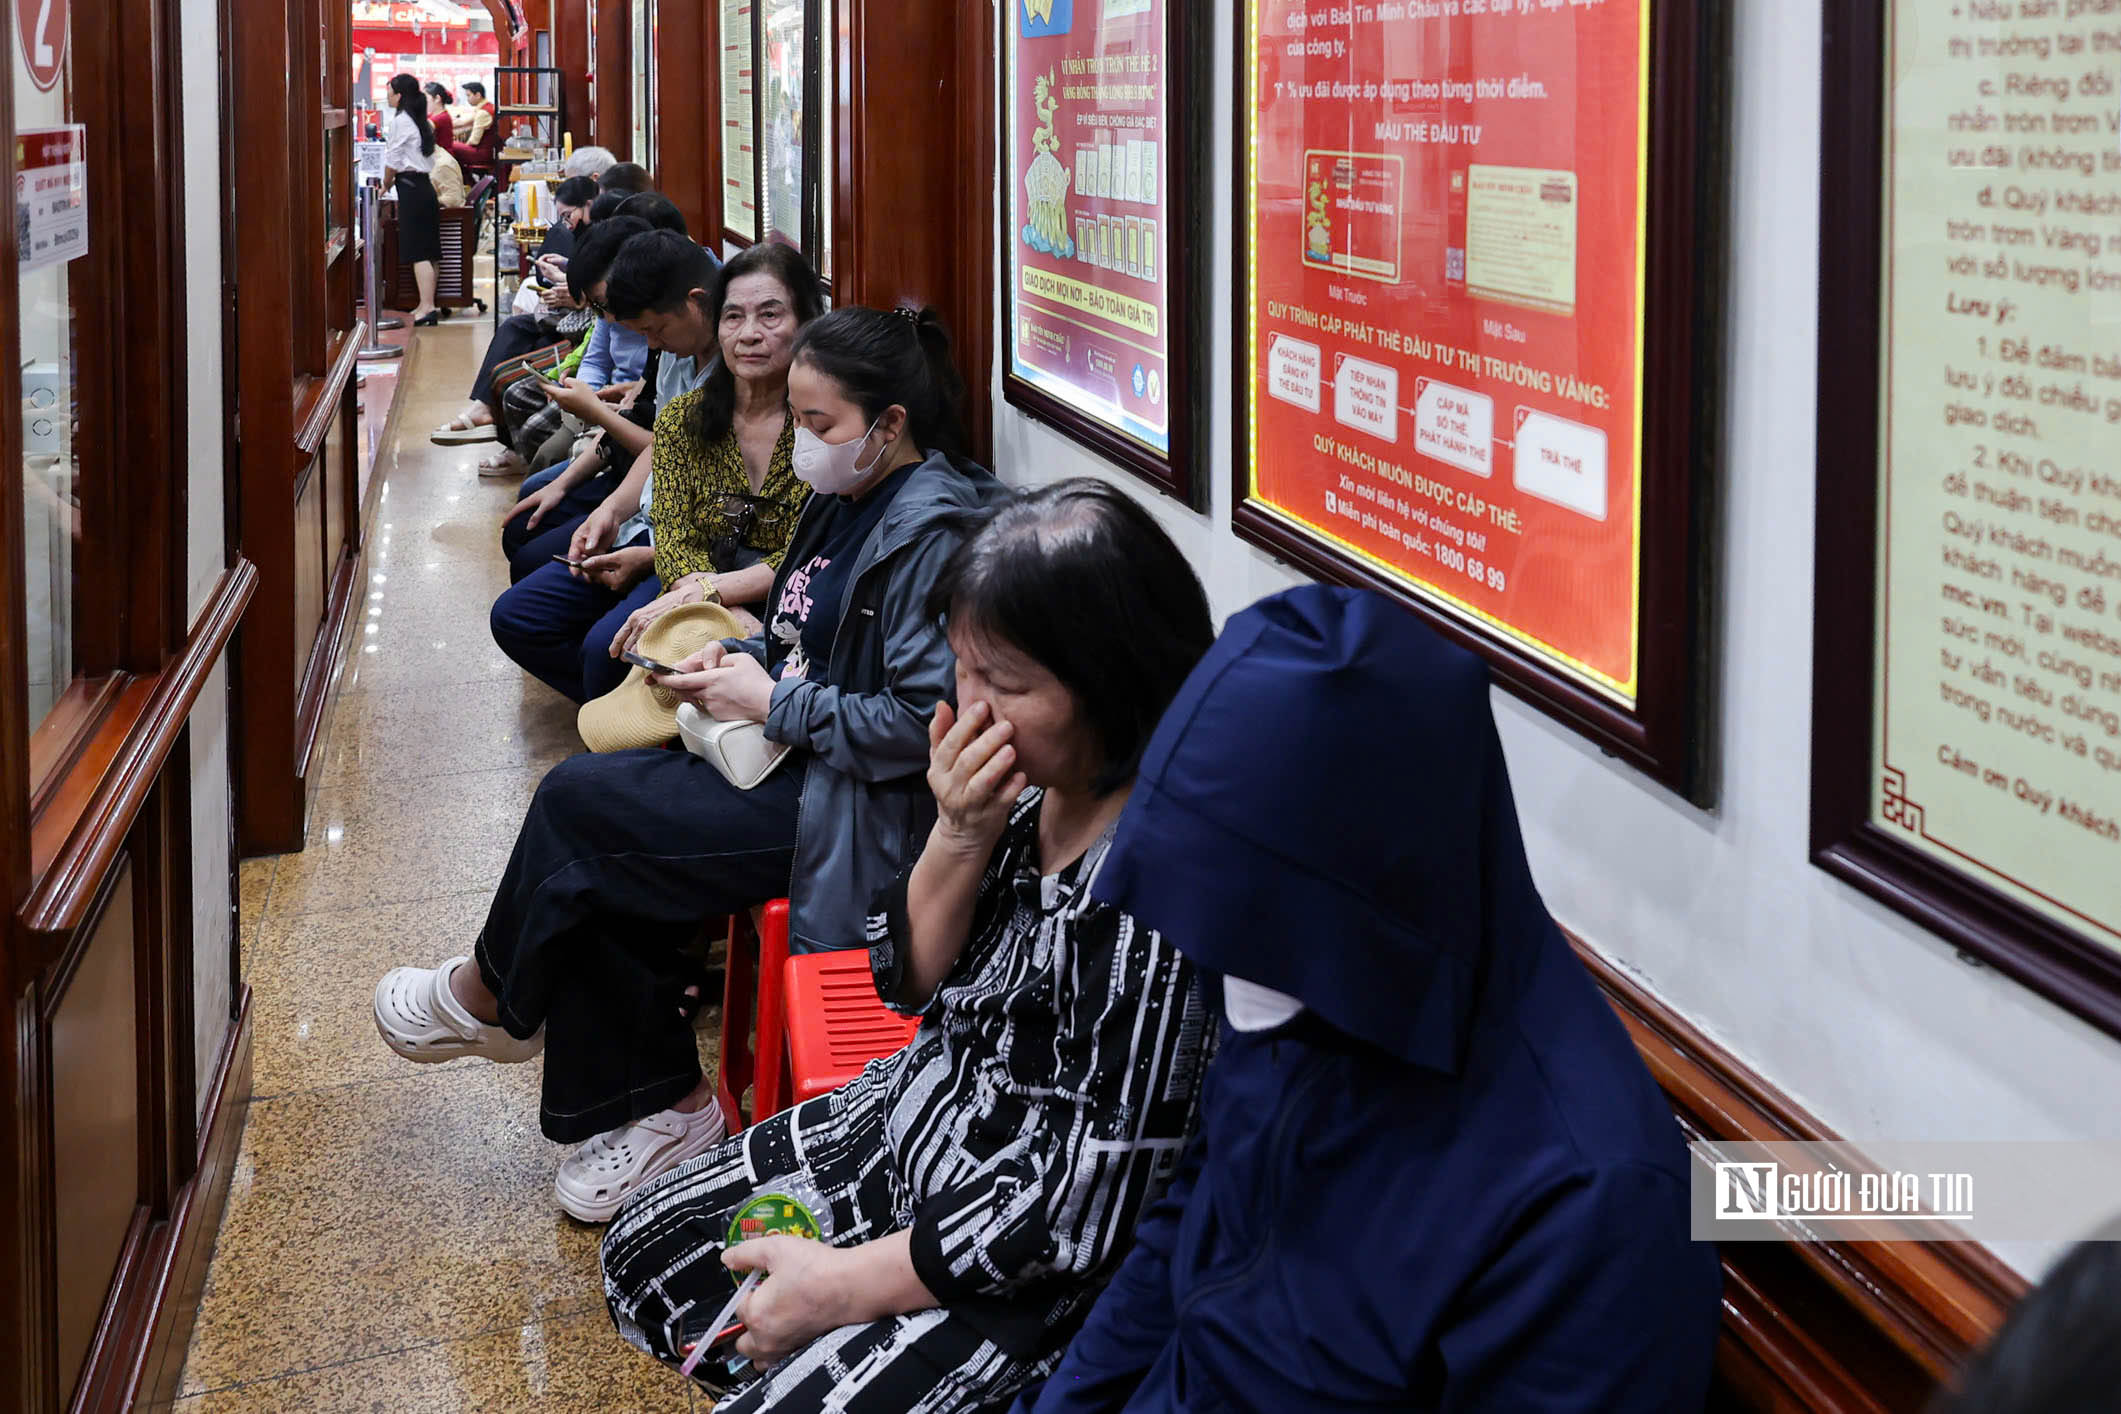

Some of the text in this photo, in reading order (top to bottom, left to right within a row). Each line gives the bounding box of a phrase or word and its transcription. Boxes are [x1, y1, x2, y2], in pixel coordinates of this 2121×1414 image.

[1287, 0, 1488, 32] dịch với Bảo Tín Minh Châu và các
[1287, 37, 1347, 59] của công ty.
[1299, 84, 1313, 99] ưu
[1315, 80, 1330, 98] đãi
[1332, 80, 1361, 102] được
[1363, 80, 1378, 101] áp
[1380, 80, 1410, 103] dụng
[1412, 80, 1440, 99] theo
[1442, 79, 1474, 104] từng
[1476, 78, 1505, 100] thời
[1507, 72, 1549, 100] điểm.
[2005, 71, 2070, 102] Riêng
[2077, 65, 2113, 96] đối
[1430, 119, 1459, 145] ĐẦU
[1462, 123, 1483, 146] TƯ
[2052, 112, 2099, 135] trơn
[2017, 144, 2096, 177] (không
[2004, 184, 2049, 217] Quý
[2041, 222, 2102, 258] Vàng
[1983, 249, 2010, 280] số
[2013, 257, 2081, 294] lượng
[1024, 271, 1156, 334] GIAO DỊCH MỌI NƠI BẢO TOÀN GIÁ TRỊ
[1344, 287, 1368, 307] Trước
[1946, 290, 1992, 318] Lưu
[1483, 318, 1527, 344] Mặt Sau
[1268, 300, 1611, 411] QUY TRÌNH CẤP PHÁT THẺ ĐẦU TƯ THỊ TRƯỜNG VÀNG:
[2000, 335, 2088, 374] Để đảm
[1350, 369, 1387, 392] TIẾP NHẬN
[1945, 363, 1978, 391] lưu
[1349, 386, 1387, 409] THÔNG TIN
[1351, 402, 1384, 424] VÀO MÁY
[1436, 396, 1453, 412] CẤP
[1945, 401, 1988, 427] giao
[1419, 427, 1487, 463] PHÁT HÀNH THẺ
[1563, 452, 1584, 475] THẺ
[1998, 449, 2033, 478] Khi
[2037, 457, 2083, 496] Quý
[1313, 432, 1524, 536] QUÝ KHÁCH MUỐN ĐƯỢC CẤP THẺ:
[1943, 470, 2080, 527] để thuận tiện
[1338, 473, 1488, 553] Xin mời liên hệ với chúng tôi!
[1338, 497, 1507, 593] Miễn phí toàn quốc: 1800 68 99
[1942, 509, 2053, 560] Quý khách
[1943, 543, 2003, 582] khách
[2012, 564, 2067, 608] hàng
[2077, 582, 2107, 614] để
[2020, 602, 2054, 634] Tại
[1942, 615, 1979, 644] sức
[1984, 631, 2031, 666] mới,
[2037, 648, 2093, 690] cùng
[1941, 646, 2054, 708] tư vấn tiêu
[1940, 681, 2089, 758] trong nước và
[1937, 743, 2120, 844] Cảm ơn Quý khách
